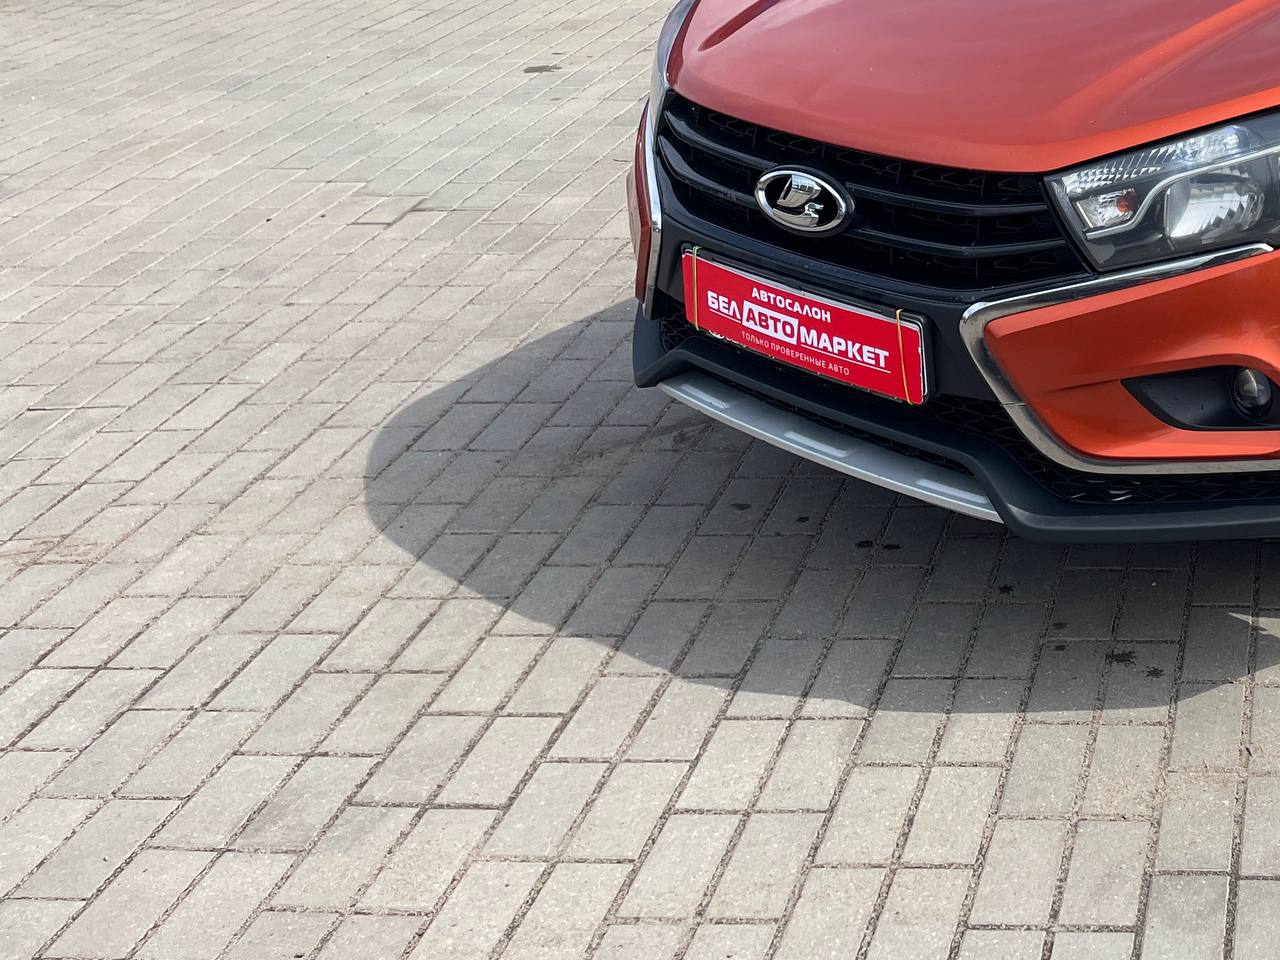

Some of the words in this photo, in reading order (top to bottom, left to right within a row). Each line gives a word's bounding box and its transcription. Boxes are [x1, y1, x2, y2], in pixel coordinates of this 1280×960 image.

[751, 287, 832, 323] АВТОСАЛОН
[707, 290, 741, 320] БЕЛ
[745, 306, 796, 340] АВТО
[800, 325, 890, 369] МАРКЕТ
[741, 331, 770, 349] ТОЛЬКО
[771, 342, 827, 368] ПРОВЕРЕННЫЕ
[828, 363, 850, 376] АВТО
